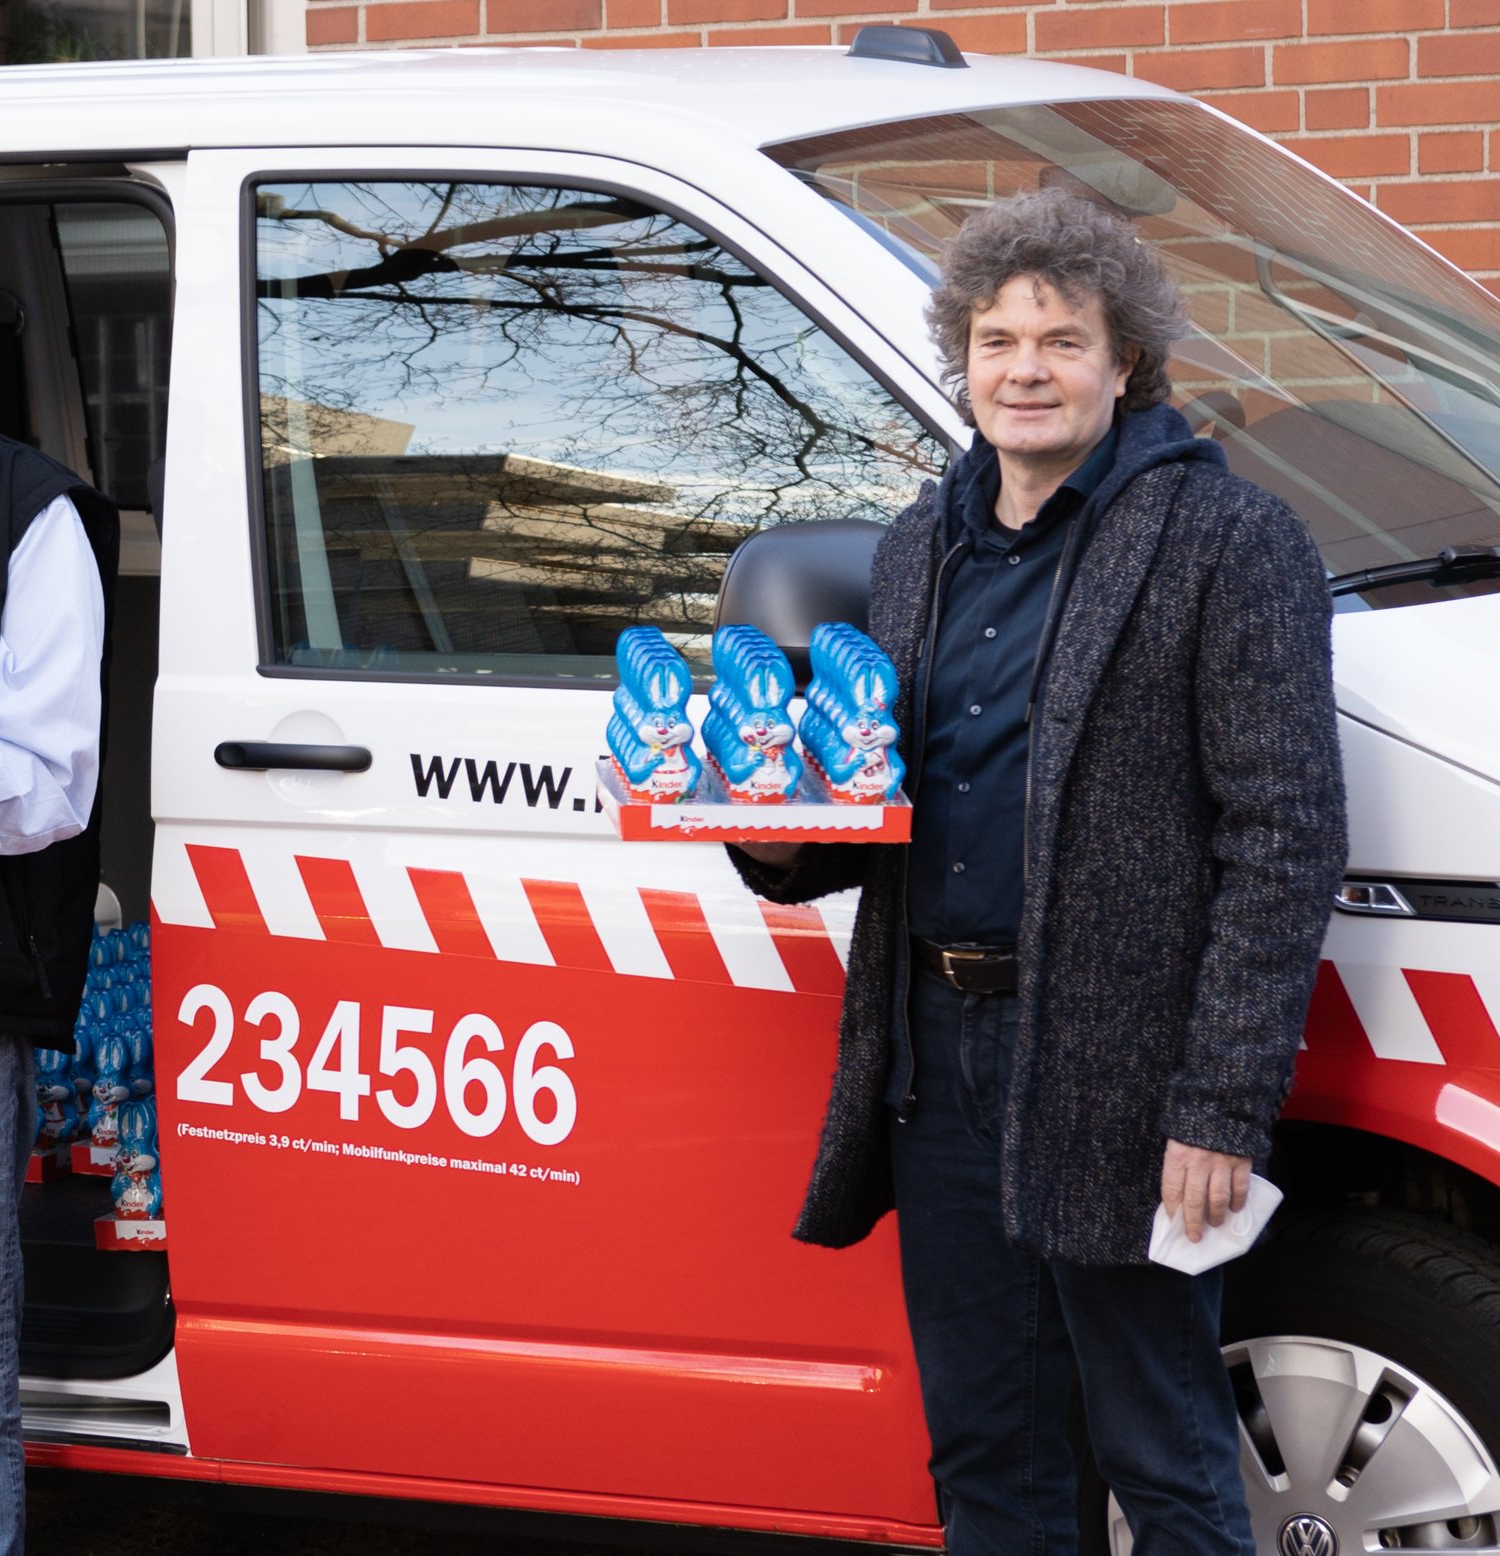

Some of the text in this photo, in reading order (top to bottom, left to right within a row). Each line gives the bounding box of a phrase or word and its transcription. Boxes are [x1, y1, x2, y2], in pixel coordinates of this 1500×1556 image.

[410, 753, 607, 814] www.
[1419, 895, 1500, 909] TRANS
[176, 984, 577, 1146] 234566
[177, 1122, 581, 1186] (Festnetzpreis 3,9 ct/min; Mobilfunkpreise maximal 42 ct/min)
